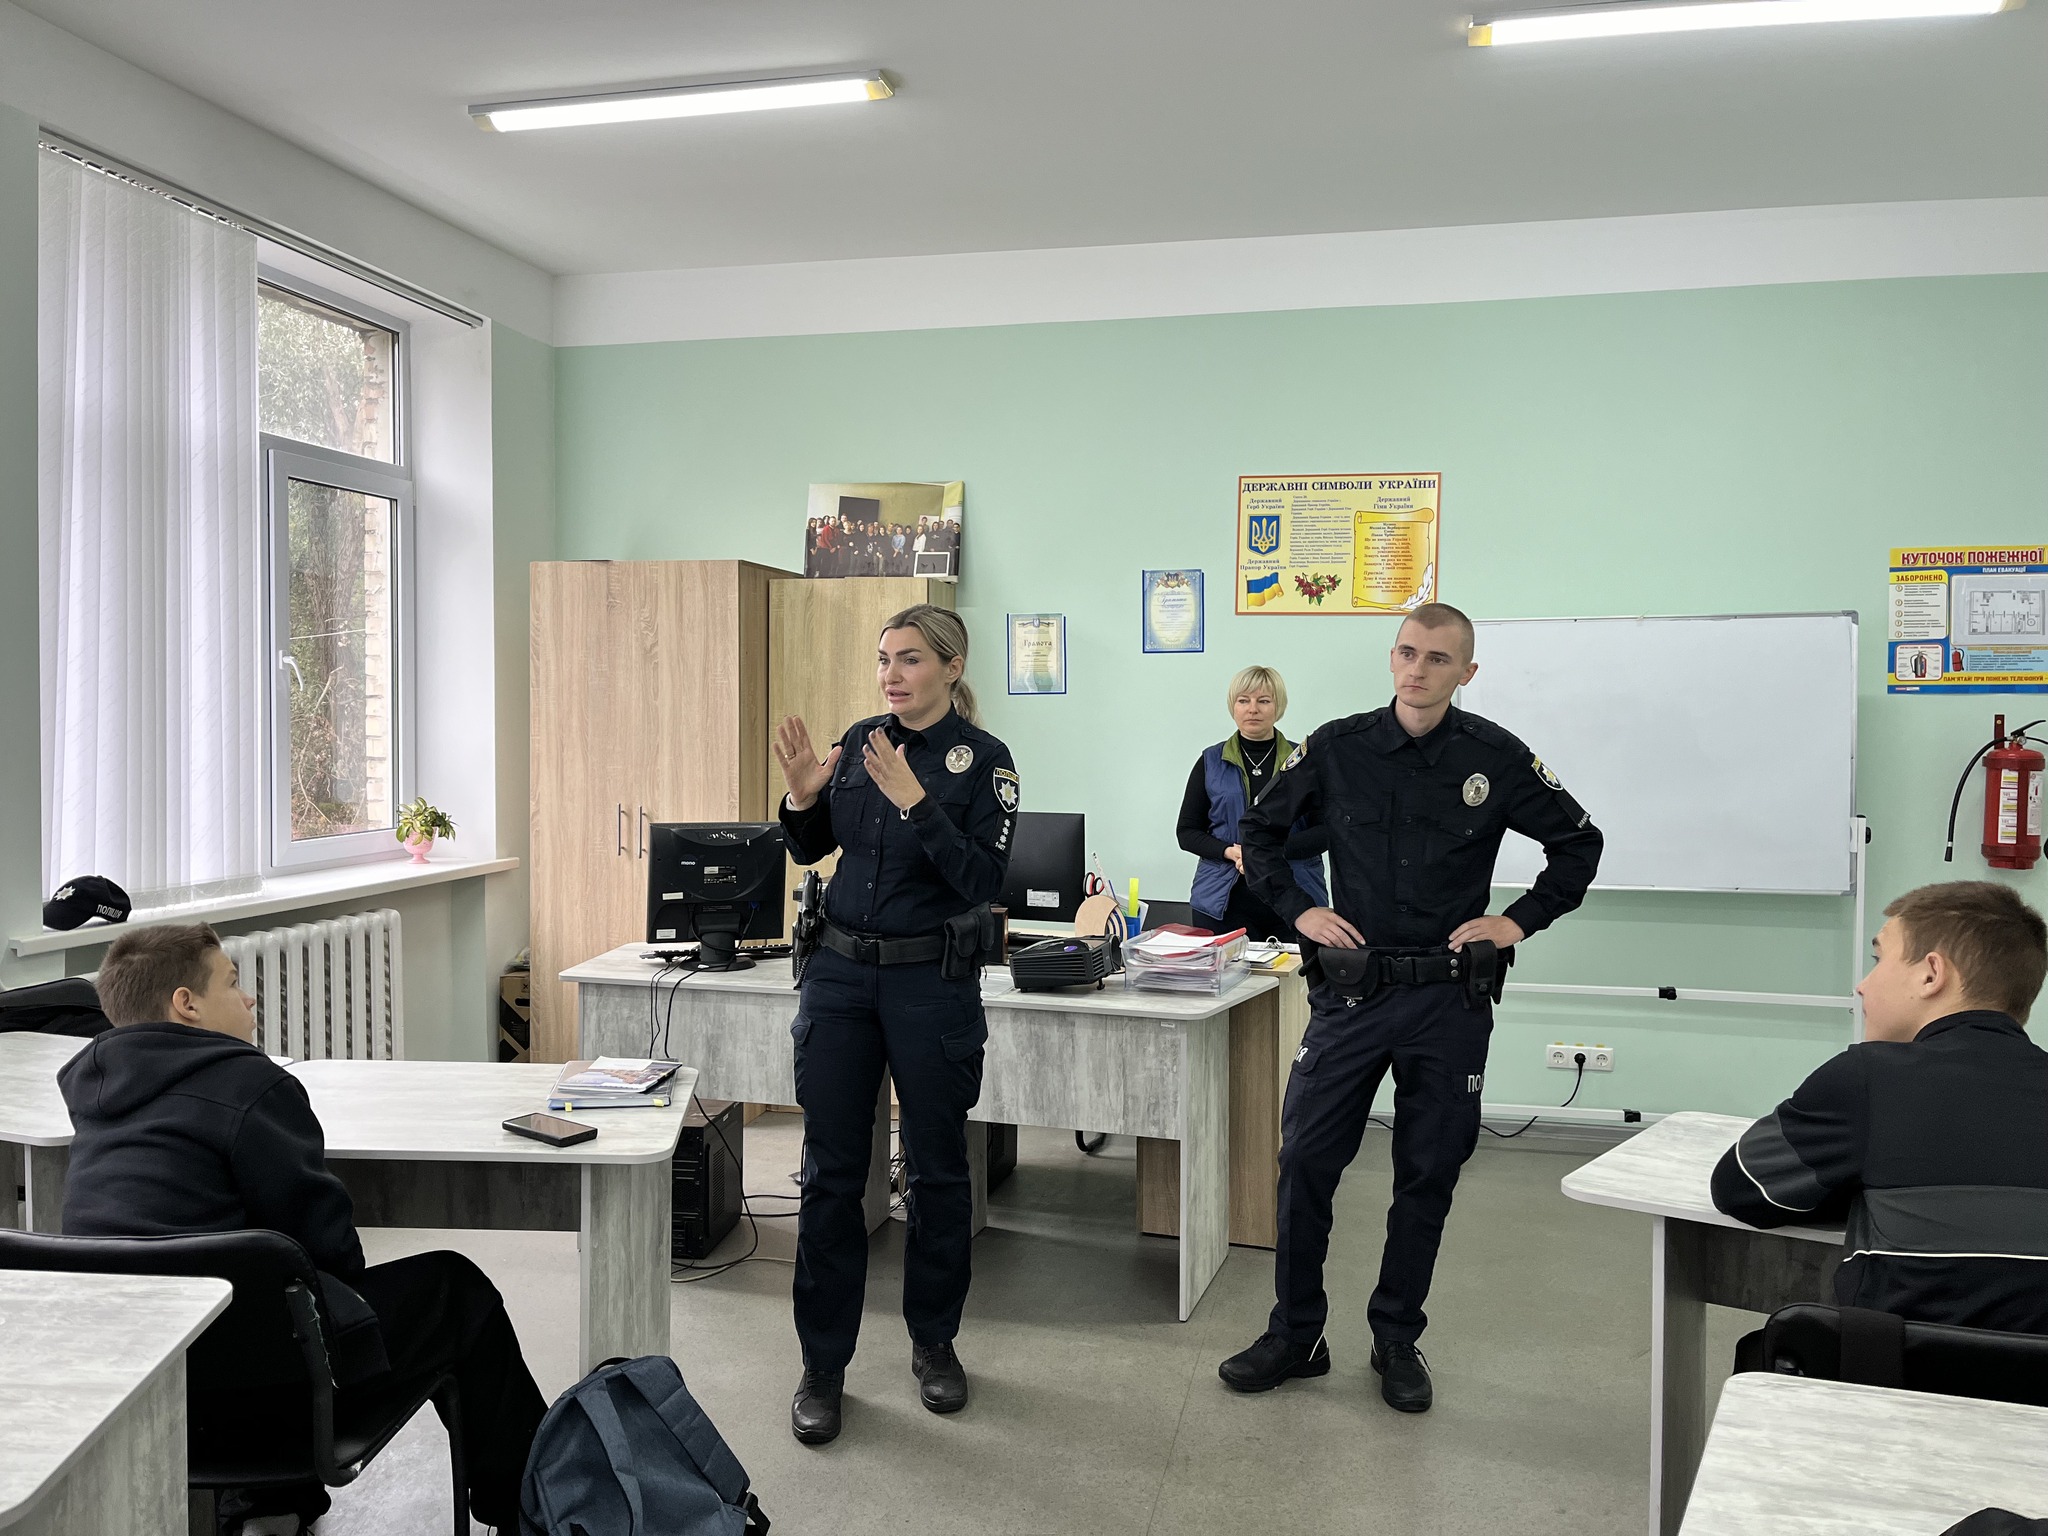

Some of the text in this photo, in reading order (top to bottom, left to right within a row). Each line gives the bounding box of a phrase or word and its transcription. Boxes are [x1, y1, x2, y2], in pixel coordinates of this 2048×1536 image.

[1242, 478, 1436, 493] ДЕРЖАВНІ СИМВОЛИ УКРАЇНИ
[1901, 547, 2044, 565] КУТОЧОК ПОЖЕЖНОЇ
[1896, 574, 1943, 582] ЗАБОРОНЕНО
[96, 904, 123, 919] ПОЛІЦІЯ
